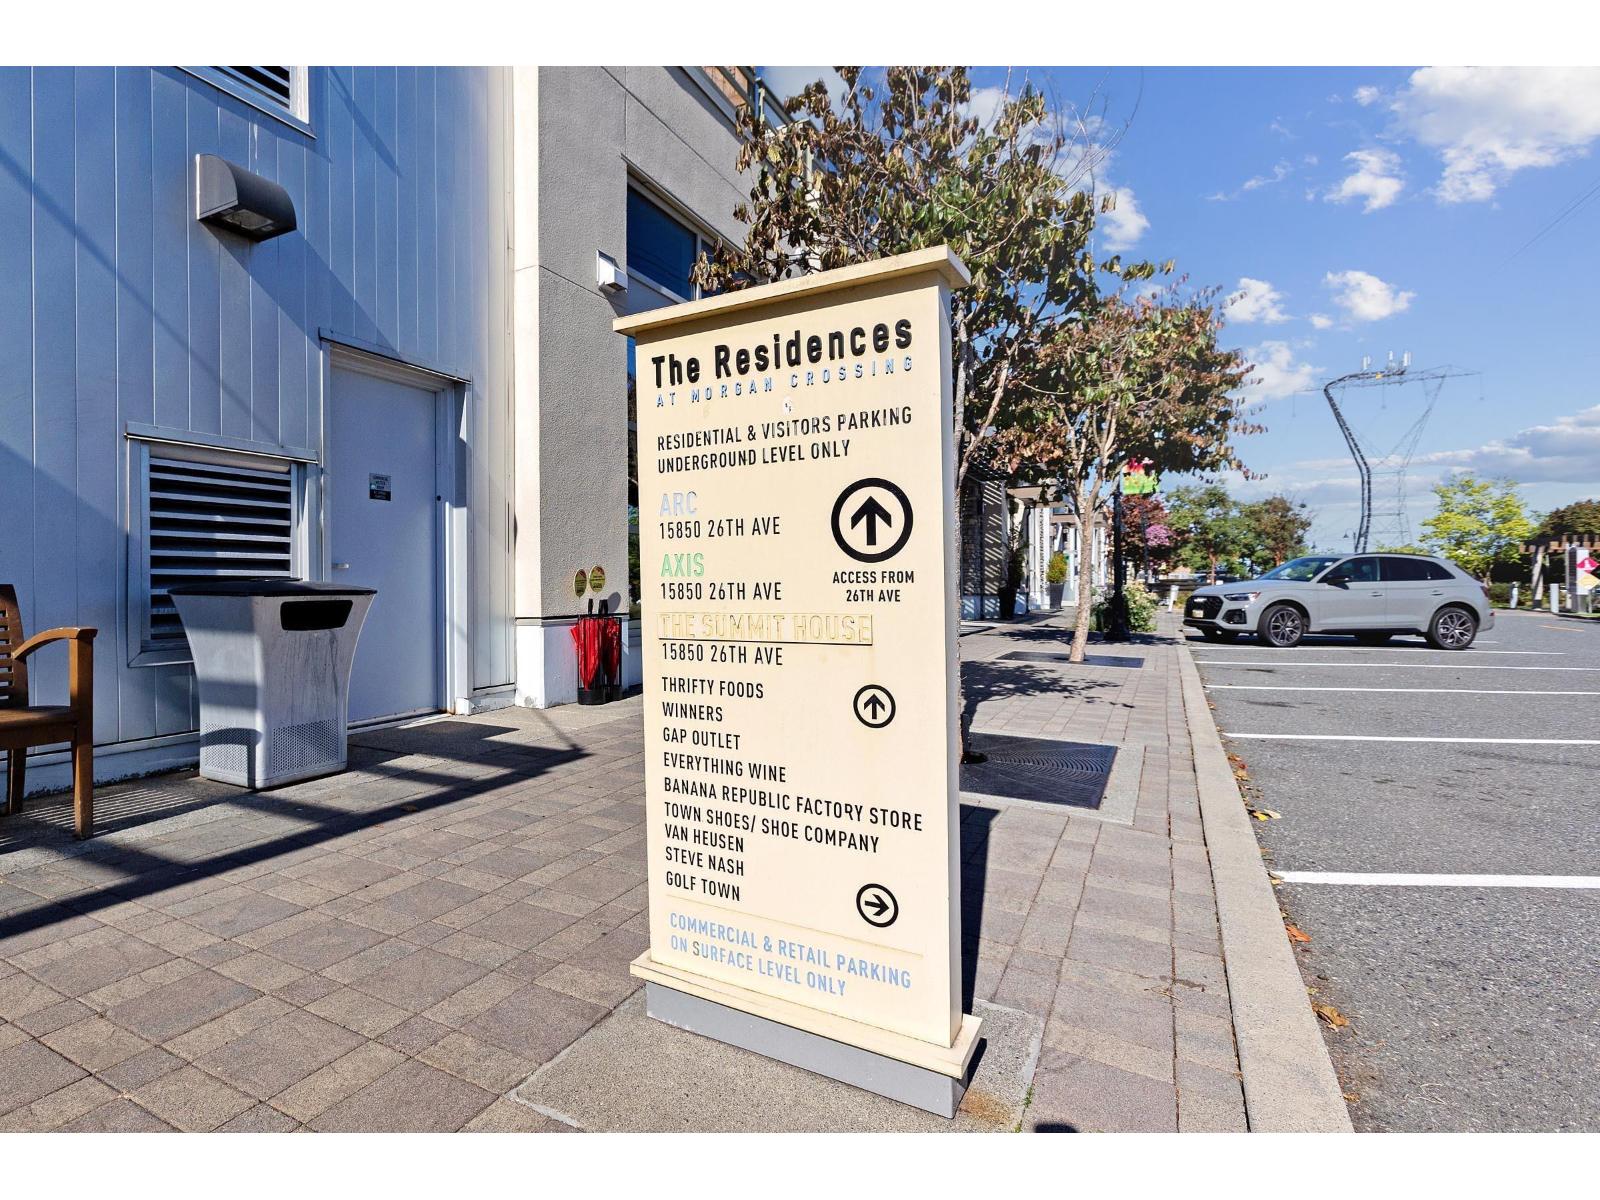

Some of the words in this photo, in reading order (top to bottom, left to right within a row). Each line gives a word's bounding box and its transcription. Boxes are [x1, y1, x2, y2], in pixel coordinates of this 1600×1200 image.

[652, 354, 699, 388] The
[714, 318, 912, 379] Residences
[656, 392, 677, 408] AT
[691, 376, 772, 402] MORGAN
[789, 355, 913, 388] CROSSING
[657, 426, 741, 451] RESIDENTIAL
[747, 425, 756, 441] &
[762, 414, 831, 439] VISITORS
[837, 406, 912, 432] PARKING
[657, 449, 756, 474] UNDERGROUND
[762, 444, 805, 465] LEVEL
[811, 439, 850, 460] ONLY
[660, 491, 698, 516] ARC
[659, 520, 701, 539] 15850
[708, 518, 744, 537] 26TH
[752, 516, 781, 535] AVE
[661, 553, 705, 577] AXIS
[833, 570, 877, 583] ACCESS
[882, 570, 915, 583] FROM
[661, 583, 702, 600] 15850
[709, 582, 746, 600] 26TH
[753, 582, 782, 600] AVE
[846, 589, 874, 602] 26TH
[879, 589, 901, 602] AVE
[661, 615, 695, 638] THE
[701, 615, 785, 640] SUMMIT
[792, 615, 872, 643] HOUSE
[662, 643, 703, 662] 15850
[710, 644, 747, 664] 26TH
[755, 647, 783, 665] AVE
[662, 677, 714, 695] THRIFTY
[719, 681, 764, 699] FOODS
[662, 702, 723, 722] WINNERS
[663, 727, 687, 744] GAP
[692, 731, 741, 750] OUTLET
[664, 752, 743, 777] EVERYTHING
[749, 763, 787, 783] WINE
[665, 777, 717, 800] BANANA
[722, 785, 790, 811] REPUBLIC
[797, 797, 863, 822] FACTORY
[869, 807, 923, 832] STORE
[665, 802, 701, 822] TOWN
[707, 809, 756, 832] SHOES/
[762, 818, 799, 839] SHOE
[804, 825, 880, 853] COMPANY
[665, 824, 688, 842] VAN
[693, 829, 744, 853] HEUSEN
[666, 847, 703, 868] STEVE
[709, 855, 744, 876] NASH
[666, 871, 696, 891] GOLF
[701, 879, 740, 901] TOWN
[670, 913, 758, 949] COMMERCIAL
[764, 936, 772, 952] &
[778, 940, 830, 969] RETAIL
[837, 954, 911, 989] PARKING
[671, 936, 687, 952] ON
[692, 942, 753, 971] SURFACE
[758, 958, 801, 984] LEVEL
[807, 971, 846, 997] ONLY
